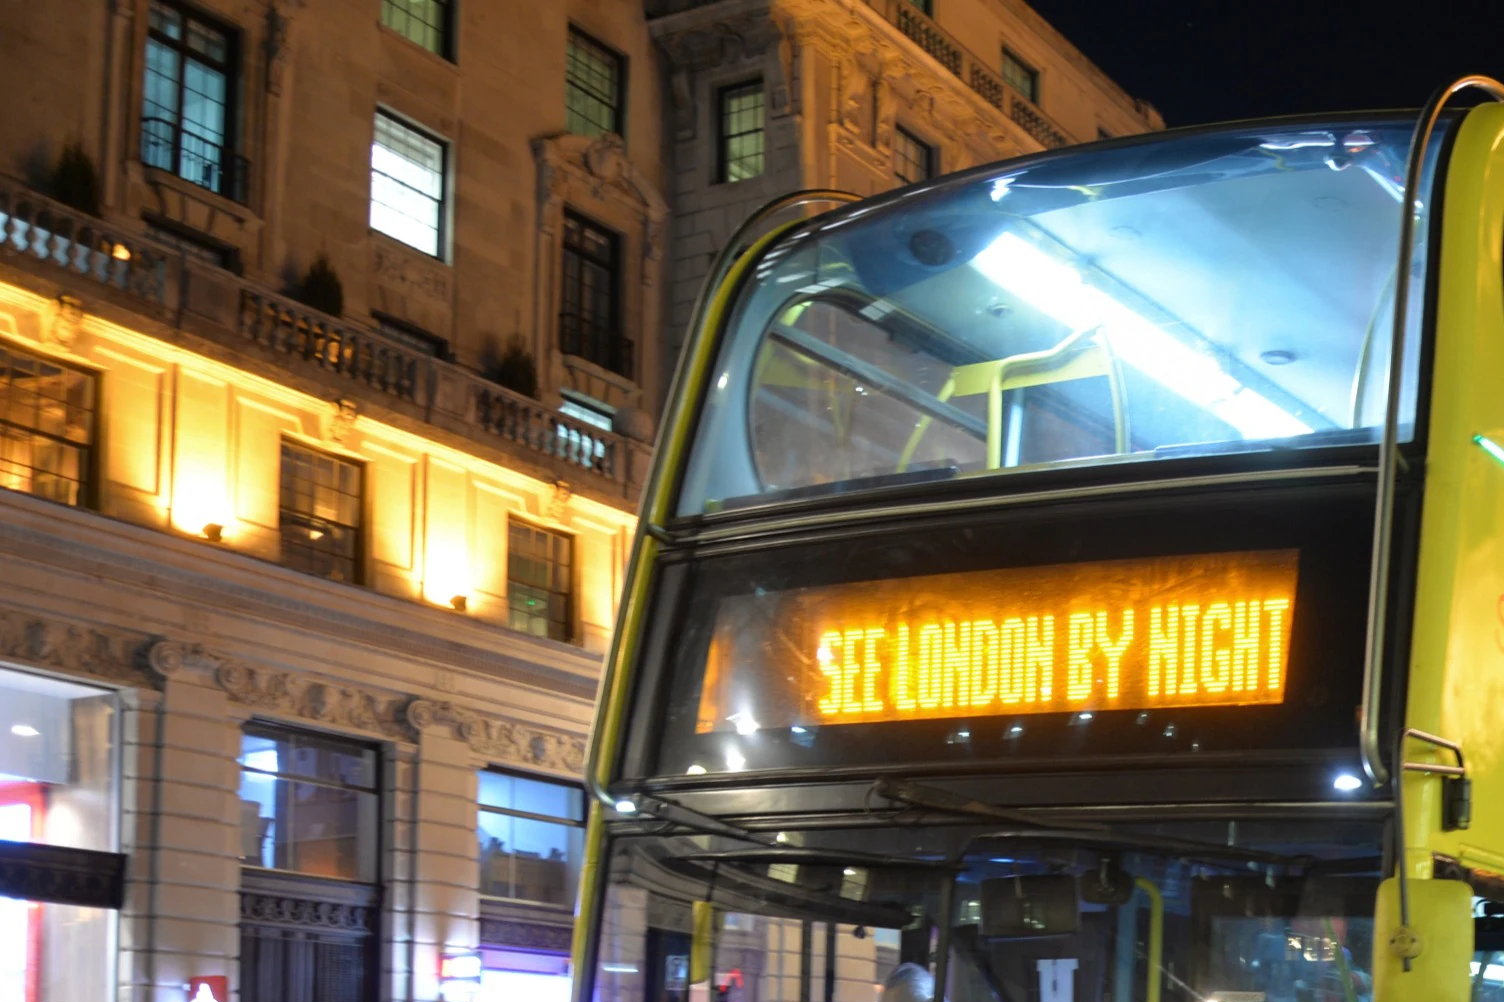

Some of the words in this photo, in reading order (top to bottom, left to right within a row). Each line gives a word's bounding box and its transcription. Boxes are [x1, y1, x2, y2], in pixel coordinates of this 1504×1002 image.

[818, 627, 885, 714] SEE
[895, 614, 1055, 711] LONDON
[1066, 609, 1135, 700] BY
[1146, 599, 1290, 697] NIGHT
